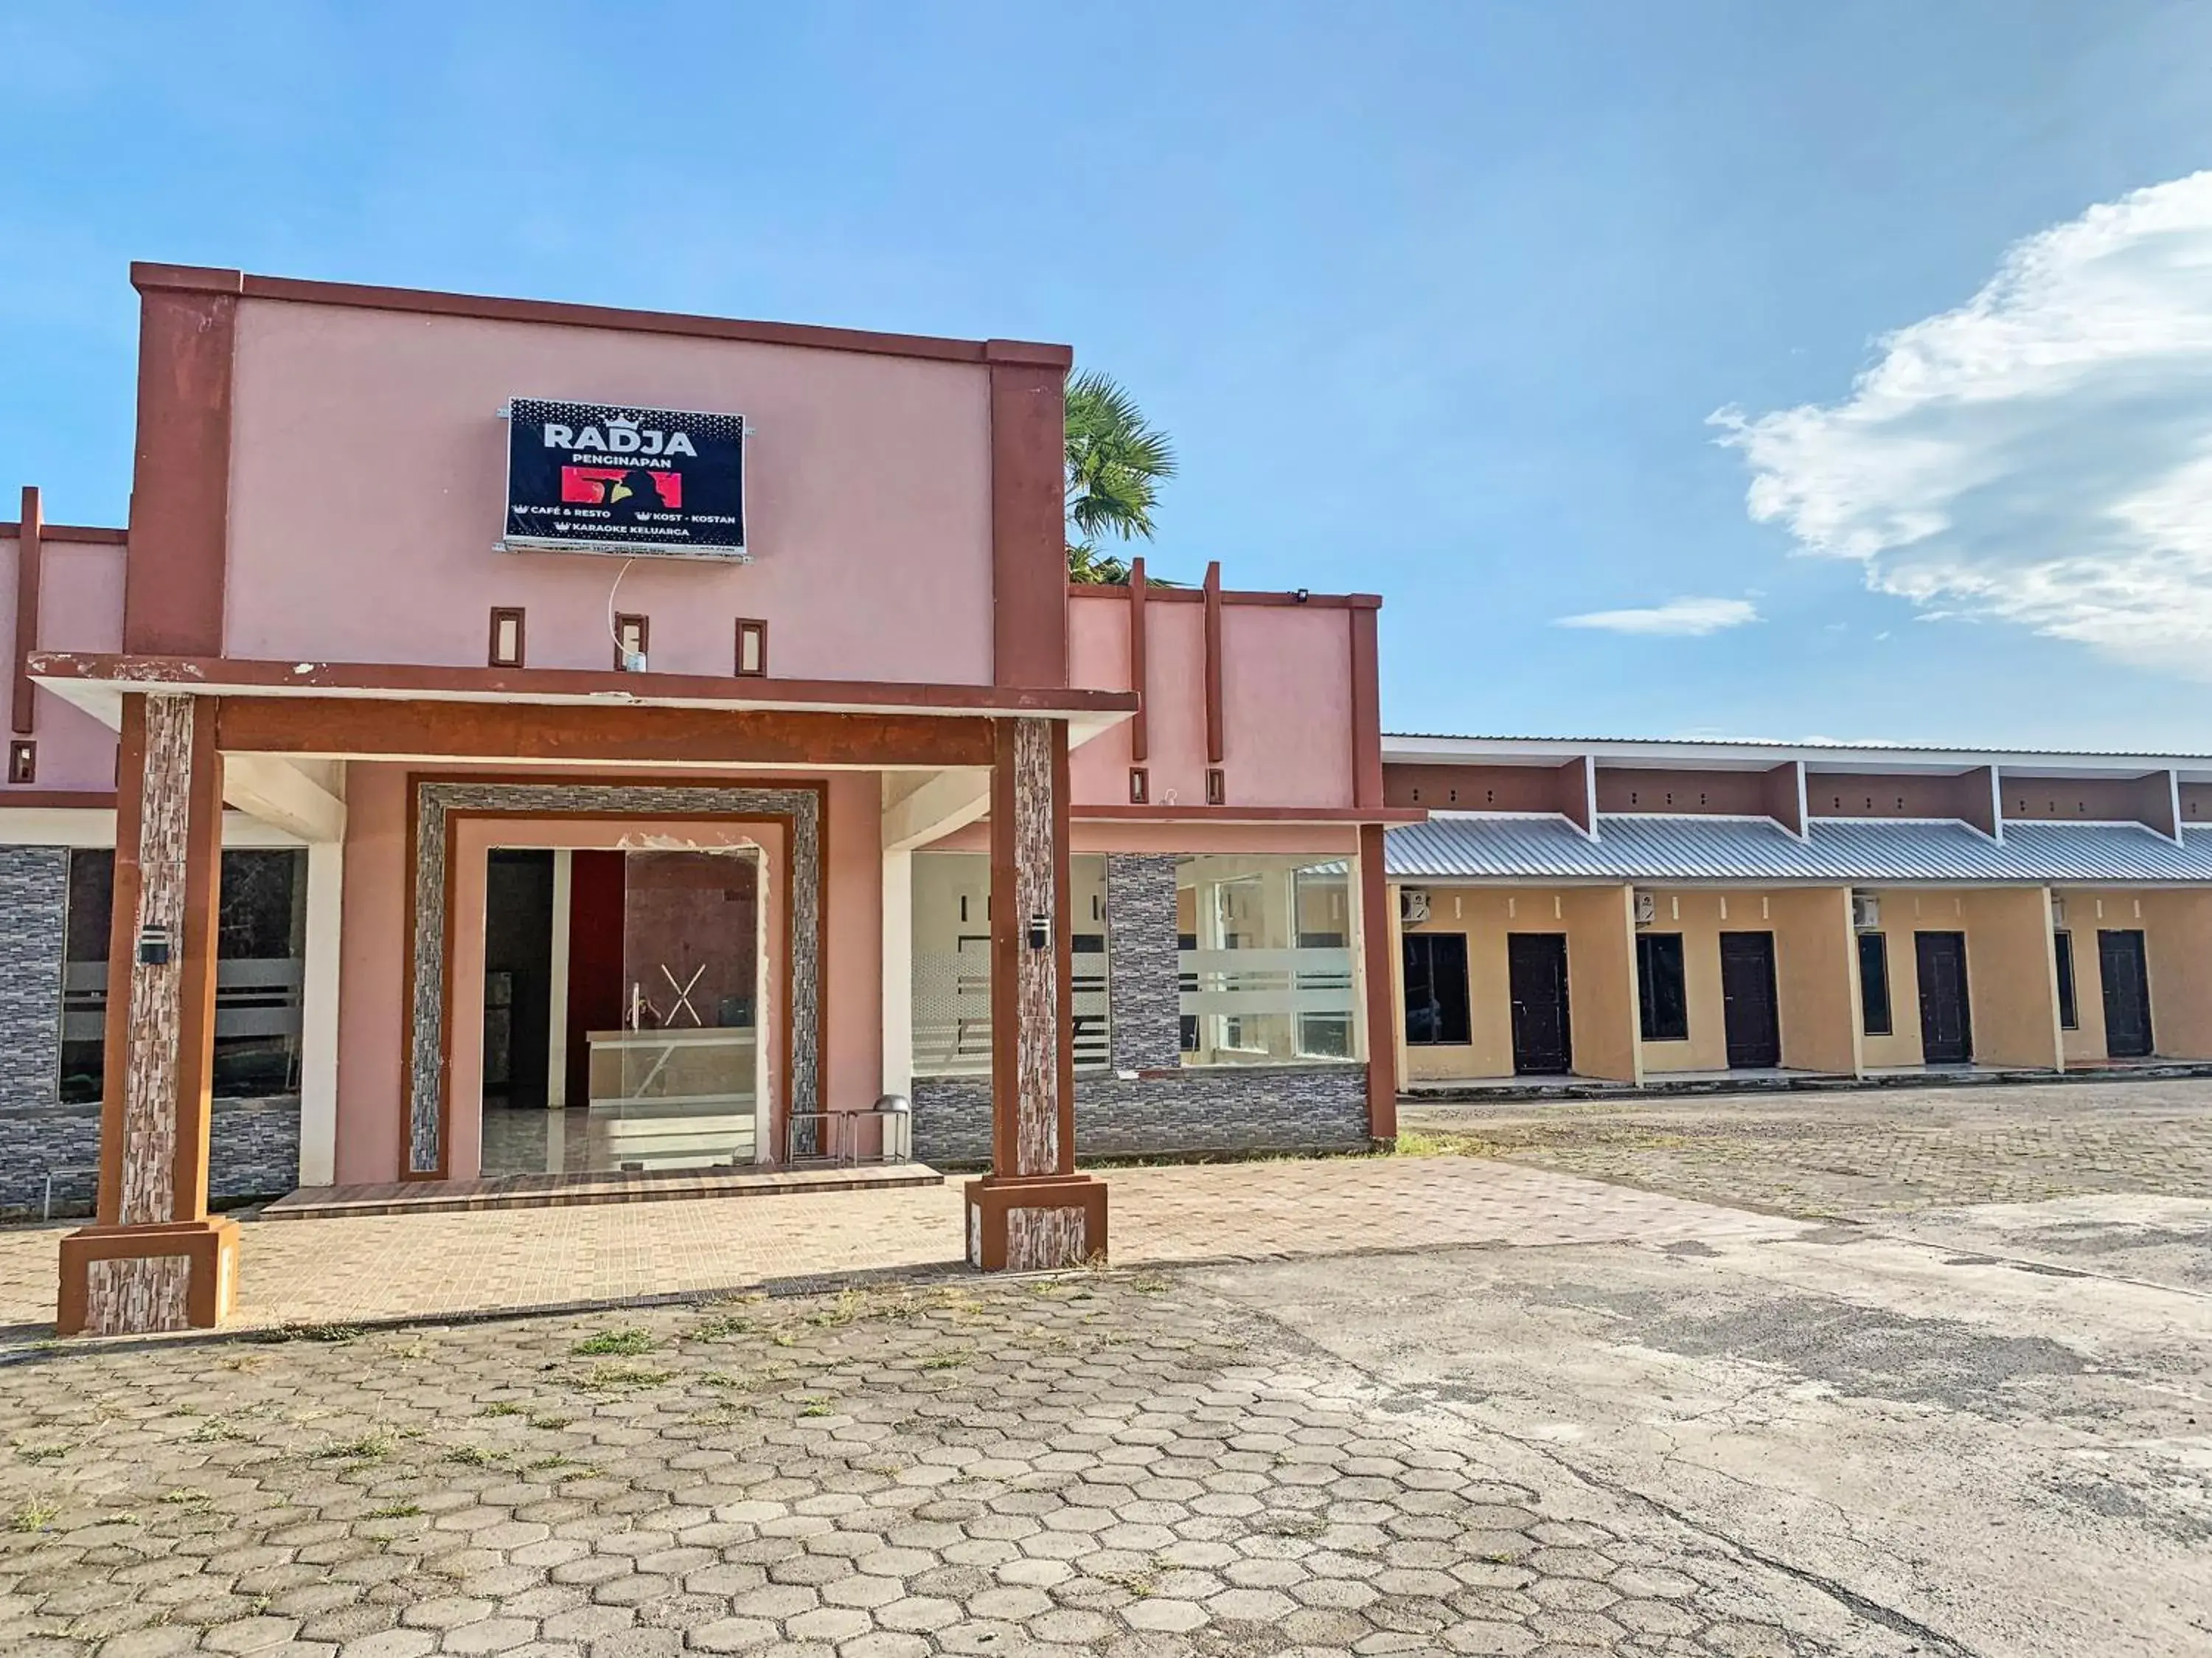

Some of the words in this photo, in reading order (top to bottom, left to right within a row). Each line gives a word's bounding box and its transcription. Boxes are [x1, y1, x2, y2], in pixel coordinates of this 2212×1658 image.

[544, 423, 698, 457] RADJA
[573, 454, 672, 468] PENGINAPAN
[530, 506, 561, 515] CAFÉ
[574, 509, 611, 518] RESTO
[653, 513, 683, 521] KOST
[692, 515, 735, 524] KOSTAN
[572, 523, 627, 533] KARAOKE
[630, 526, 689, 536] KELUARGA
